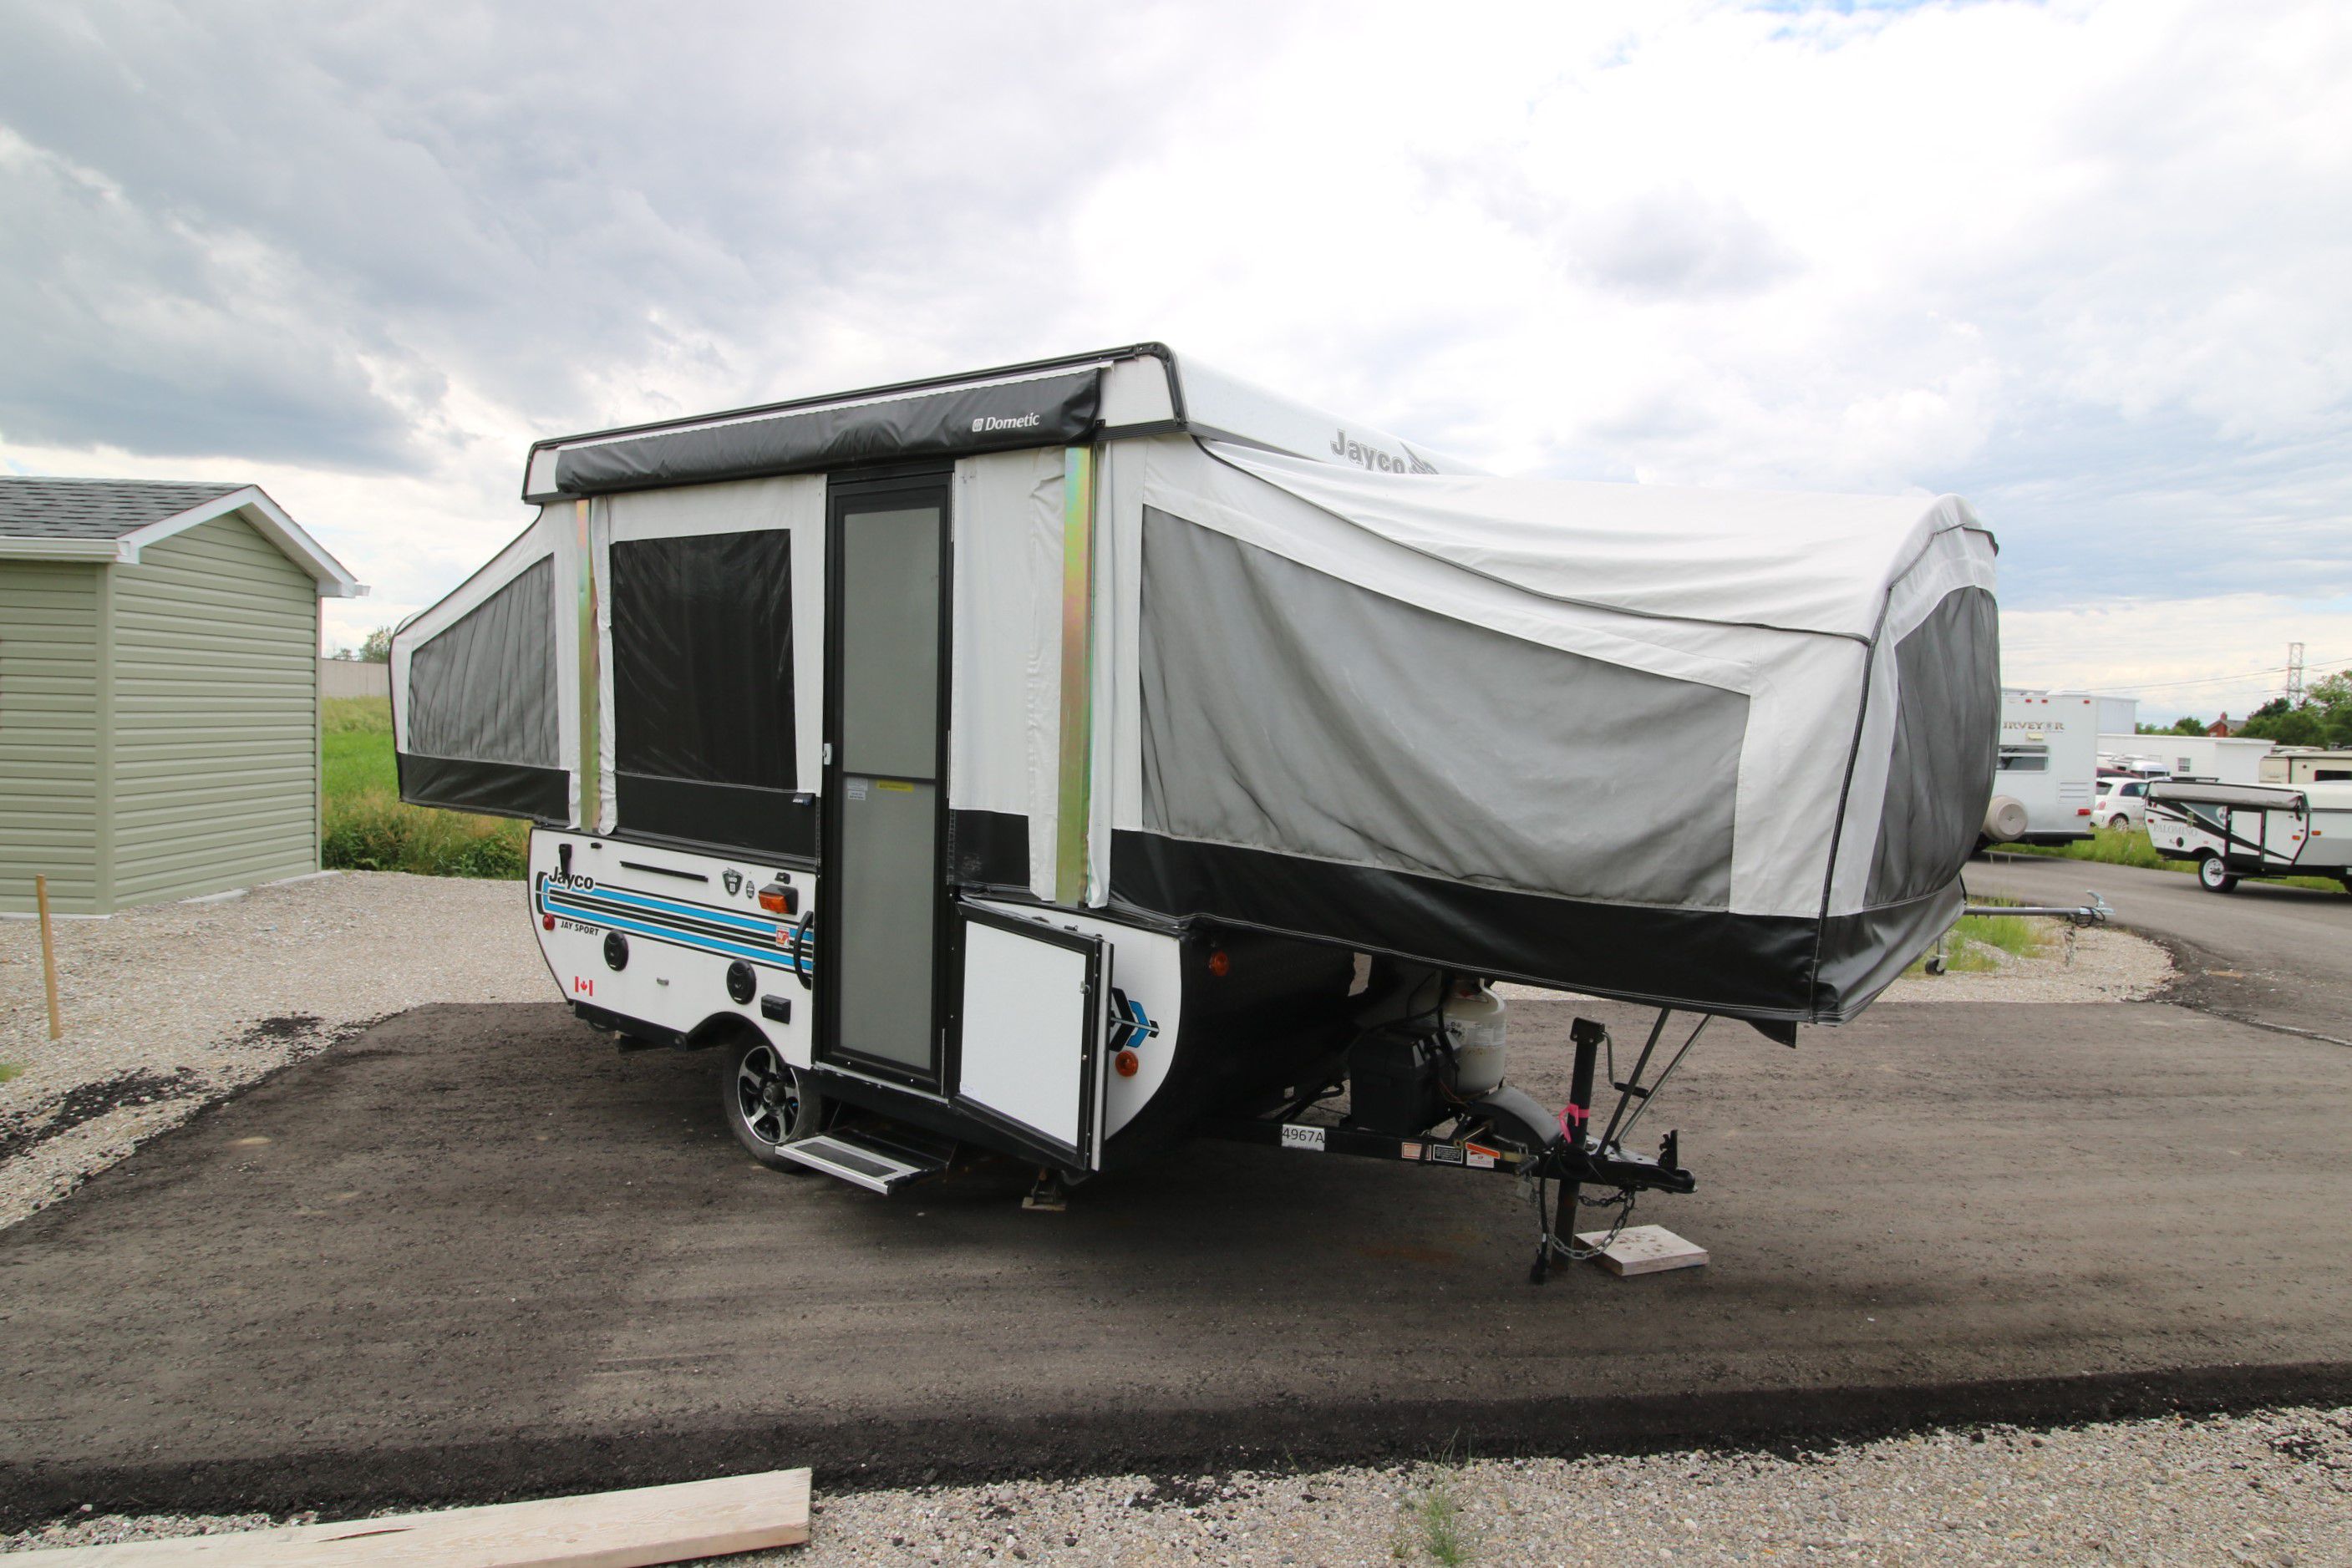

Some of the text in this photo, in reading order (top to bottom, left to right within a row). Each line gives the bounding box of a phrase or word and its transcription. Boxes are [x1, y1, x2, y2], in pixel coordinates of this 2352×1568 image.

[985, 412, 1040, 431] Dometic
[1330, 428, 1405, 474] Jayco
[548, 866, 594, 890] Jayco
[561, 921, 599, 936] JAY SPORT
[1283, 1128, 1325, 1144] 4967A
